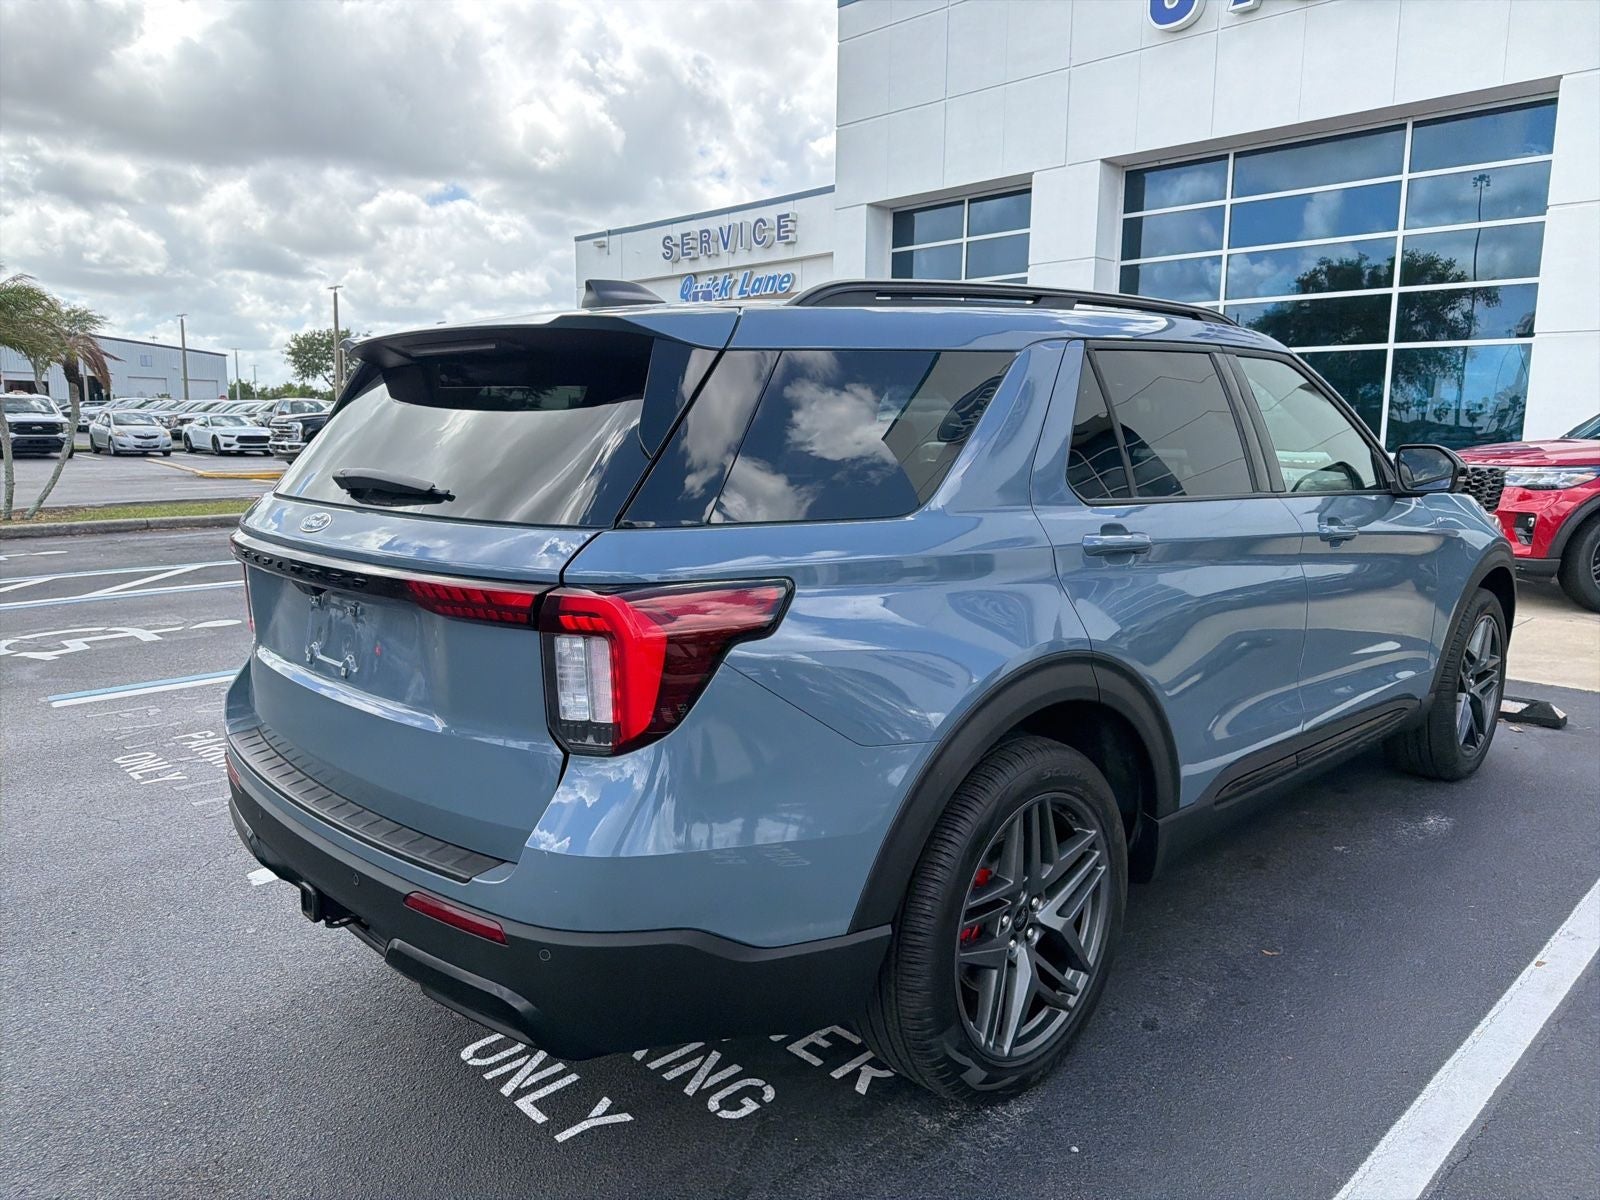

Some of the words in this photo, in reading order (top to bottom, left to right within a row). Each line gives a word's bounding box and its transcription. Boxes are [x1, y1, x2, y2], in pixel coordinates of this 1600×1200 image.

[661, 212, 797, 263] SERVICE
[738, 269, 795, 298] Lane
[113, 751, 187, 785] ONLY
[460, 1033, 634, 1143] ONLY
